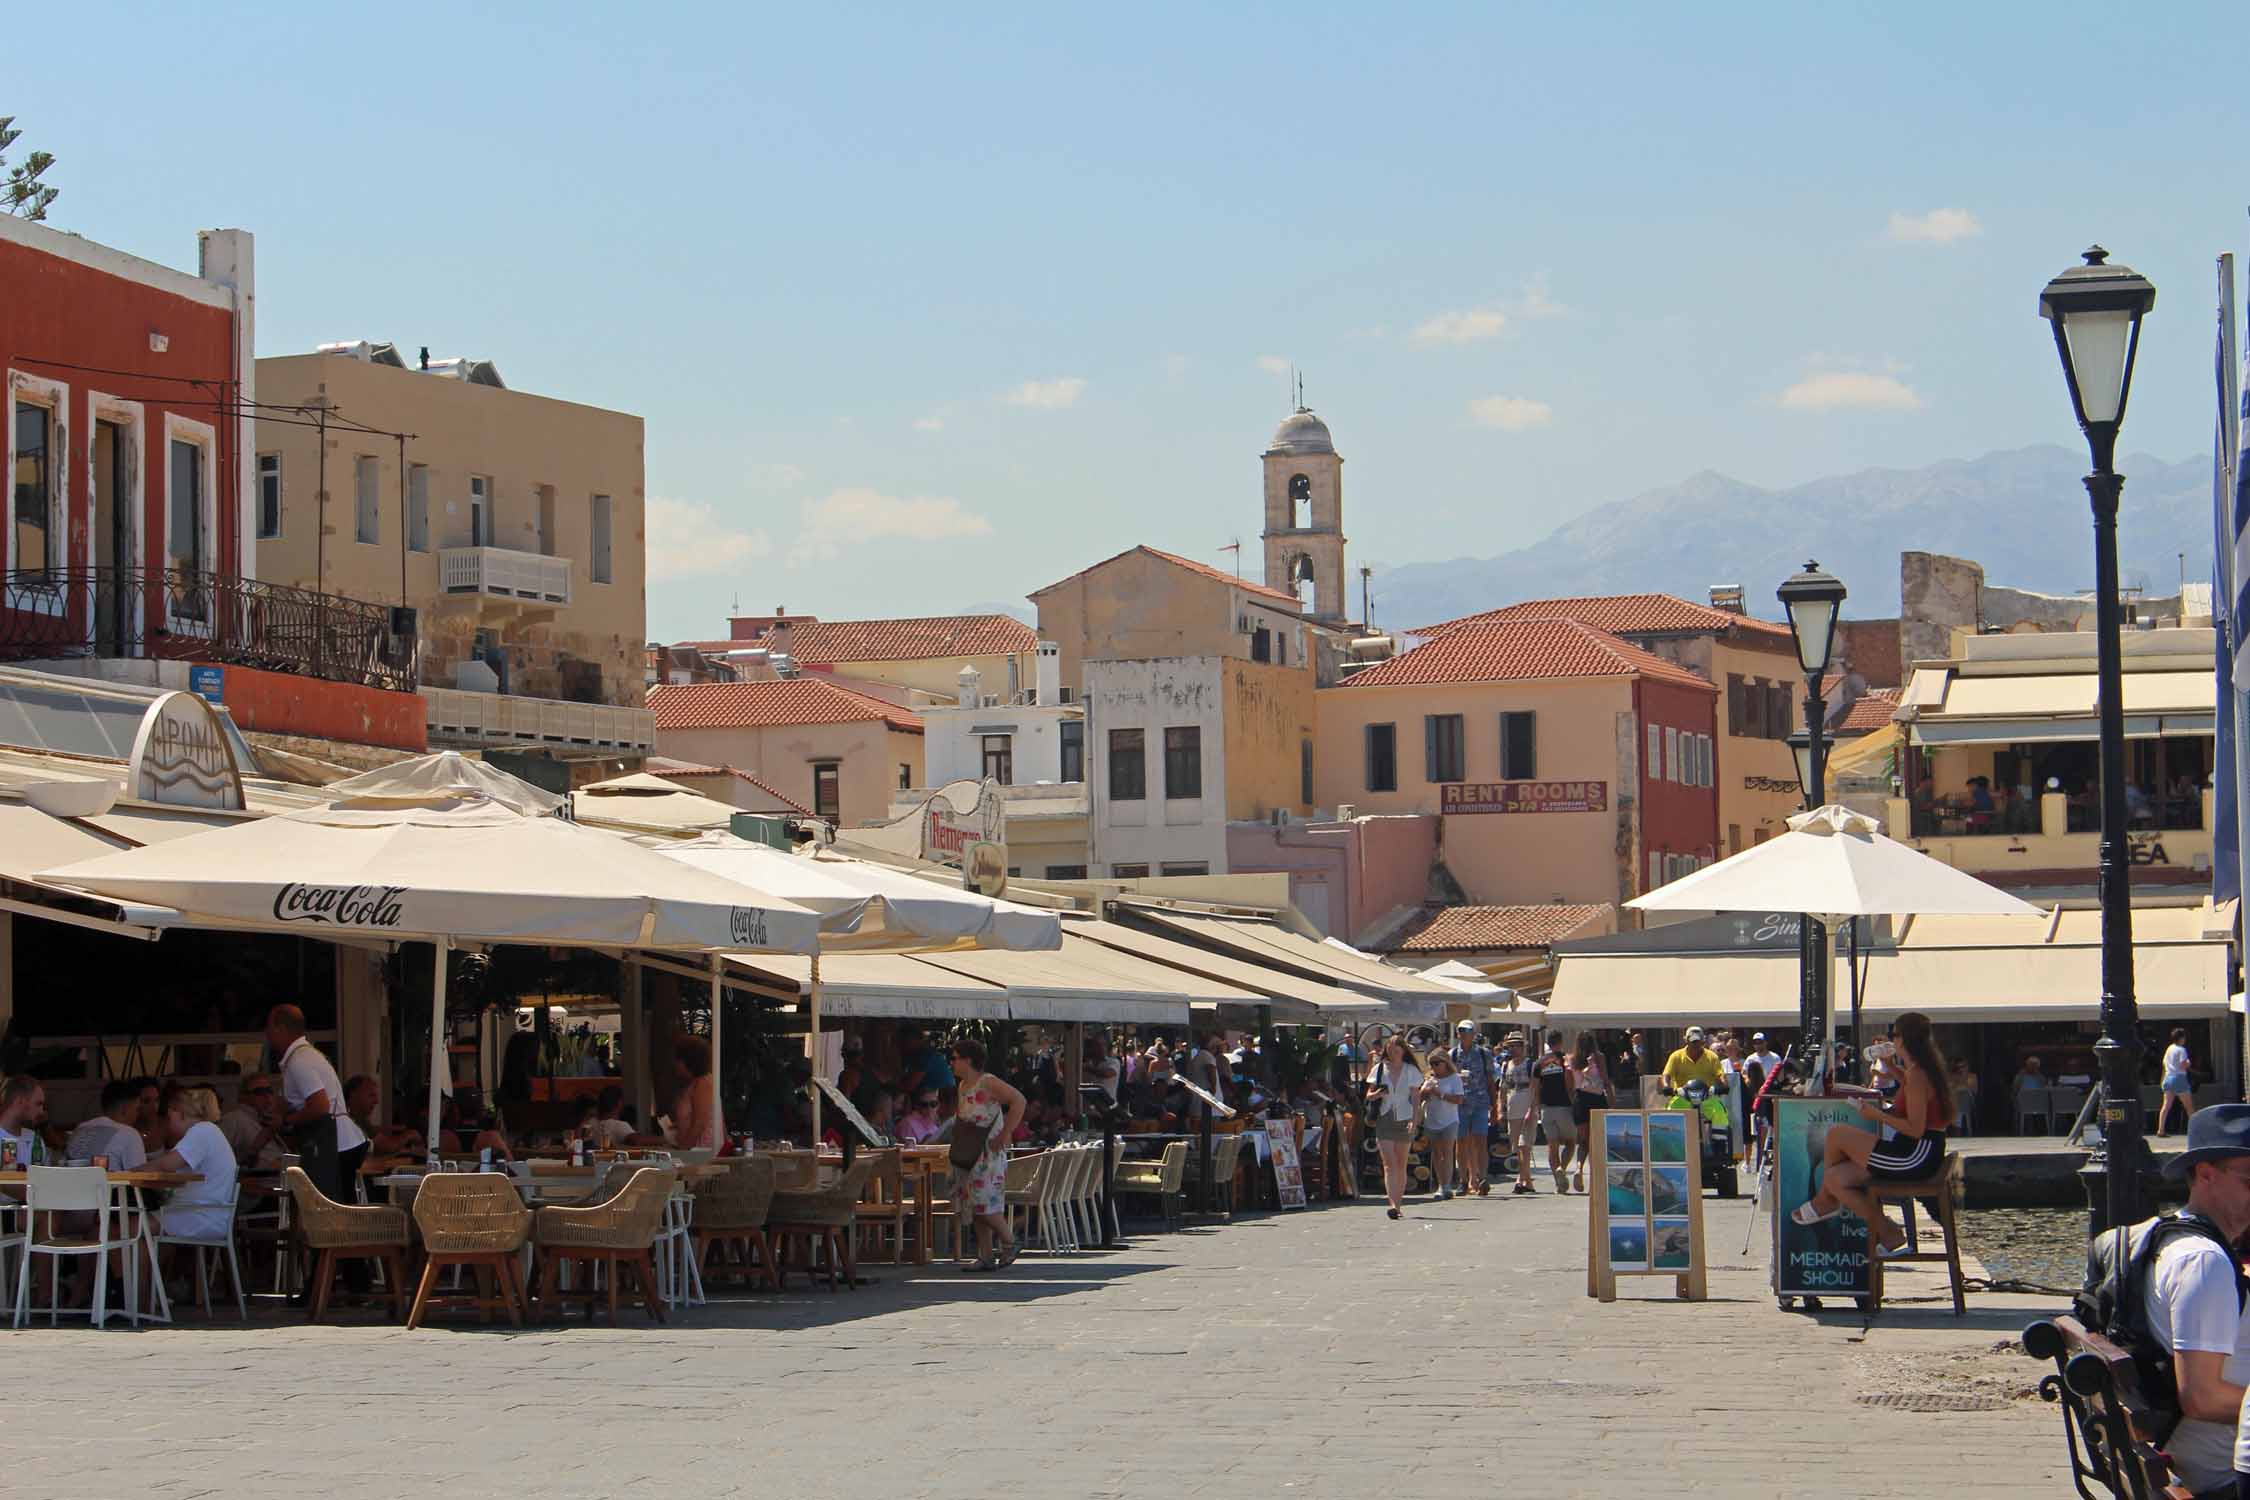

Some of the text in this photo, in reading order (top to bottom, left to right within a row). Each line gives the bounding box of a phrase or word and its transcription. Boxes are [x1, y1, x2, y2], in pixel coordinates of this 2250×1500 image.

[1447, 783, 1601, 802] RENT ROOMS
[273, 882, 408, 926] Coca-Cola
[1790, 1251, 1867, 1268] MERMAID
[1802, 1270, 1855, 1287] SHOW
